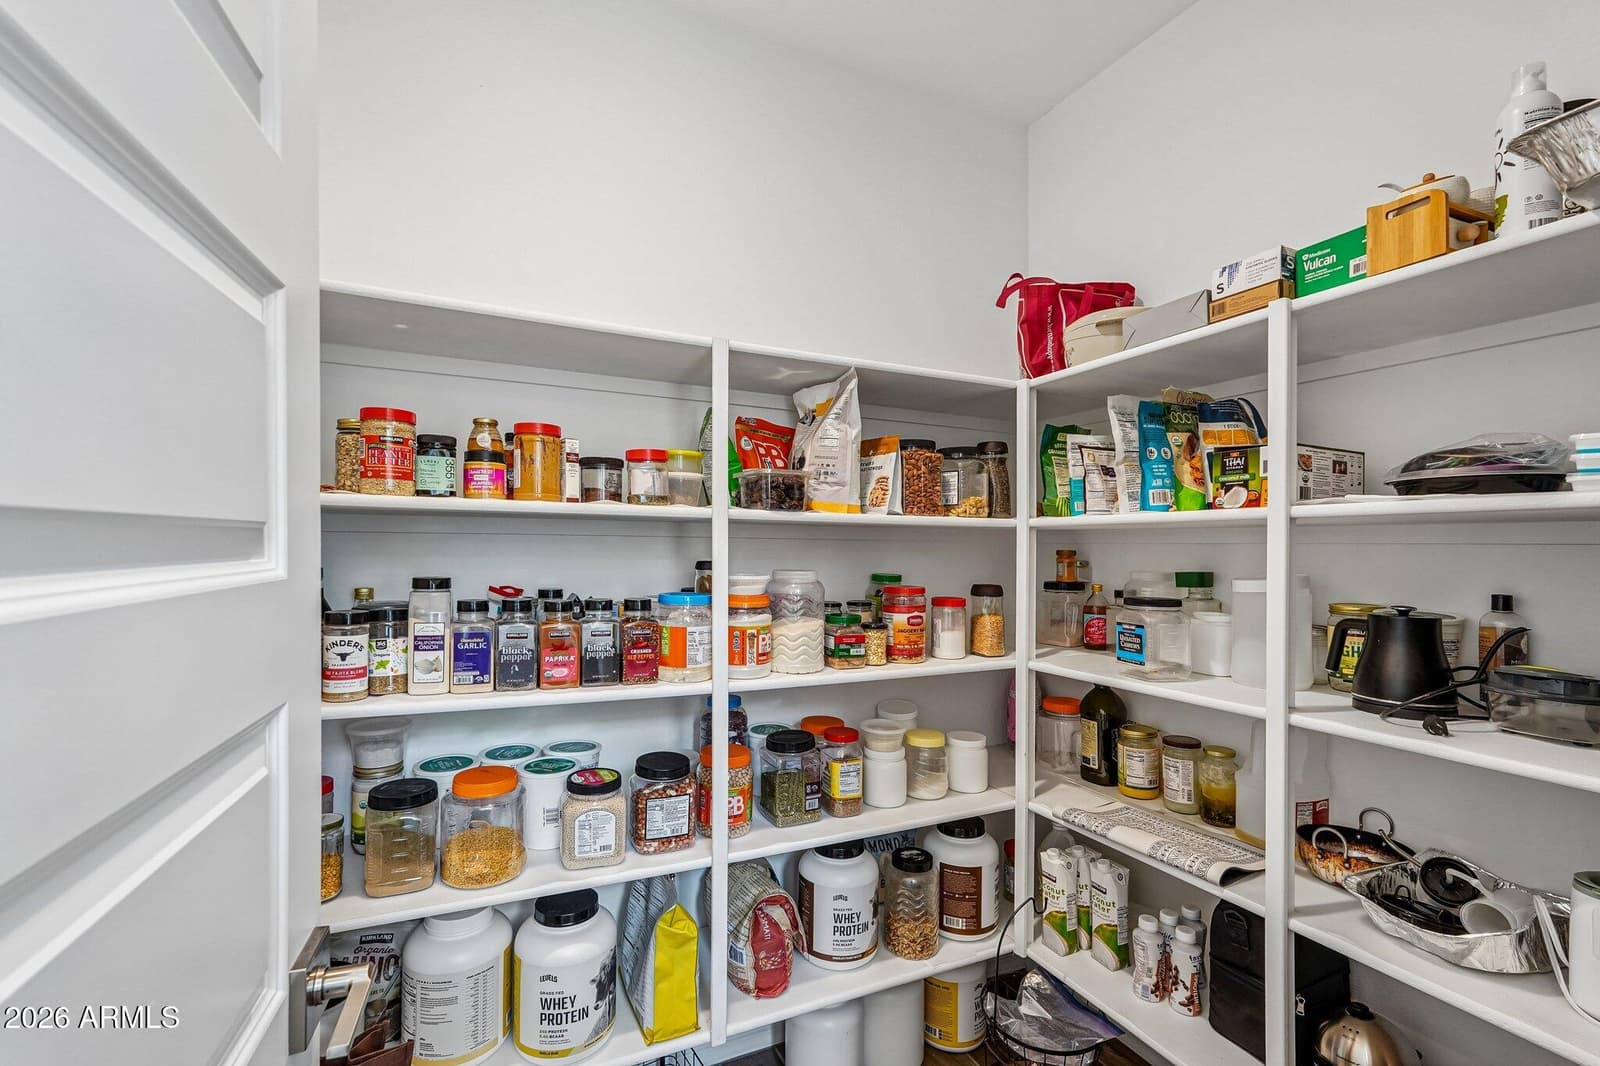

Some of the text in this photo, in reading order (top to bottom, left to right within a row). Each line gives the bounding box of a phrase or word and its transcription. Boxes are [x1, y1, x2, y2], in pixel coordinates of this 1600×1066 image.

[1286, 256, 1295, 269] S
[1304, 255, 1337, 272] Vulcan
[1217, 283, 1225, 295] S
[369, 448, 410, 461] PEANUT
[369, 457, 410, 467] BUTTER
[1224, 457, 1245, 467] THAI
[445, 459, 455, 480] 355
[457, 642, 488, 650] GARLIC
[502, 647, 529, 655] black
[588, 643, 613, 653] black
[501, 653, 533, 663] pepper
[586, 650, 616, 660] pepper
[865, 836, 901, 852] MOND
[833, 912, 862, 924] WHEY
[833, 921, 869, 937] PROTEIN
[354, 946, 395, 956] Organic
[540, 995, 577, 1011] WHEY
[540, 1005, 589, 1026] PROTEIN
